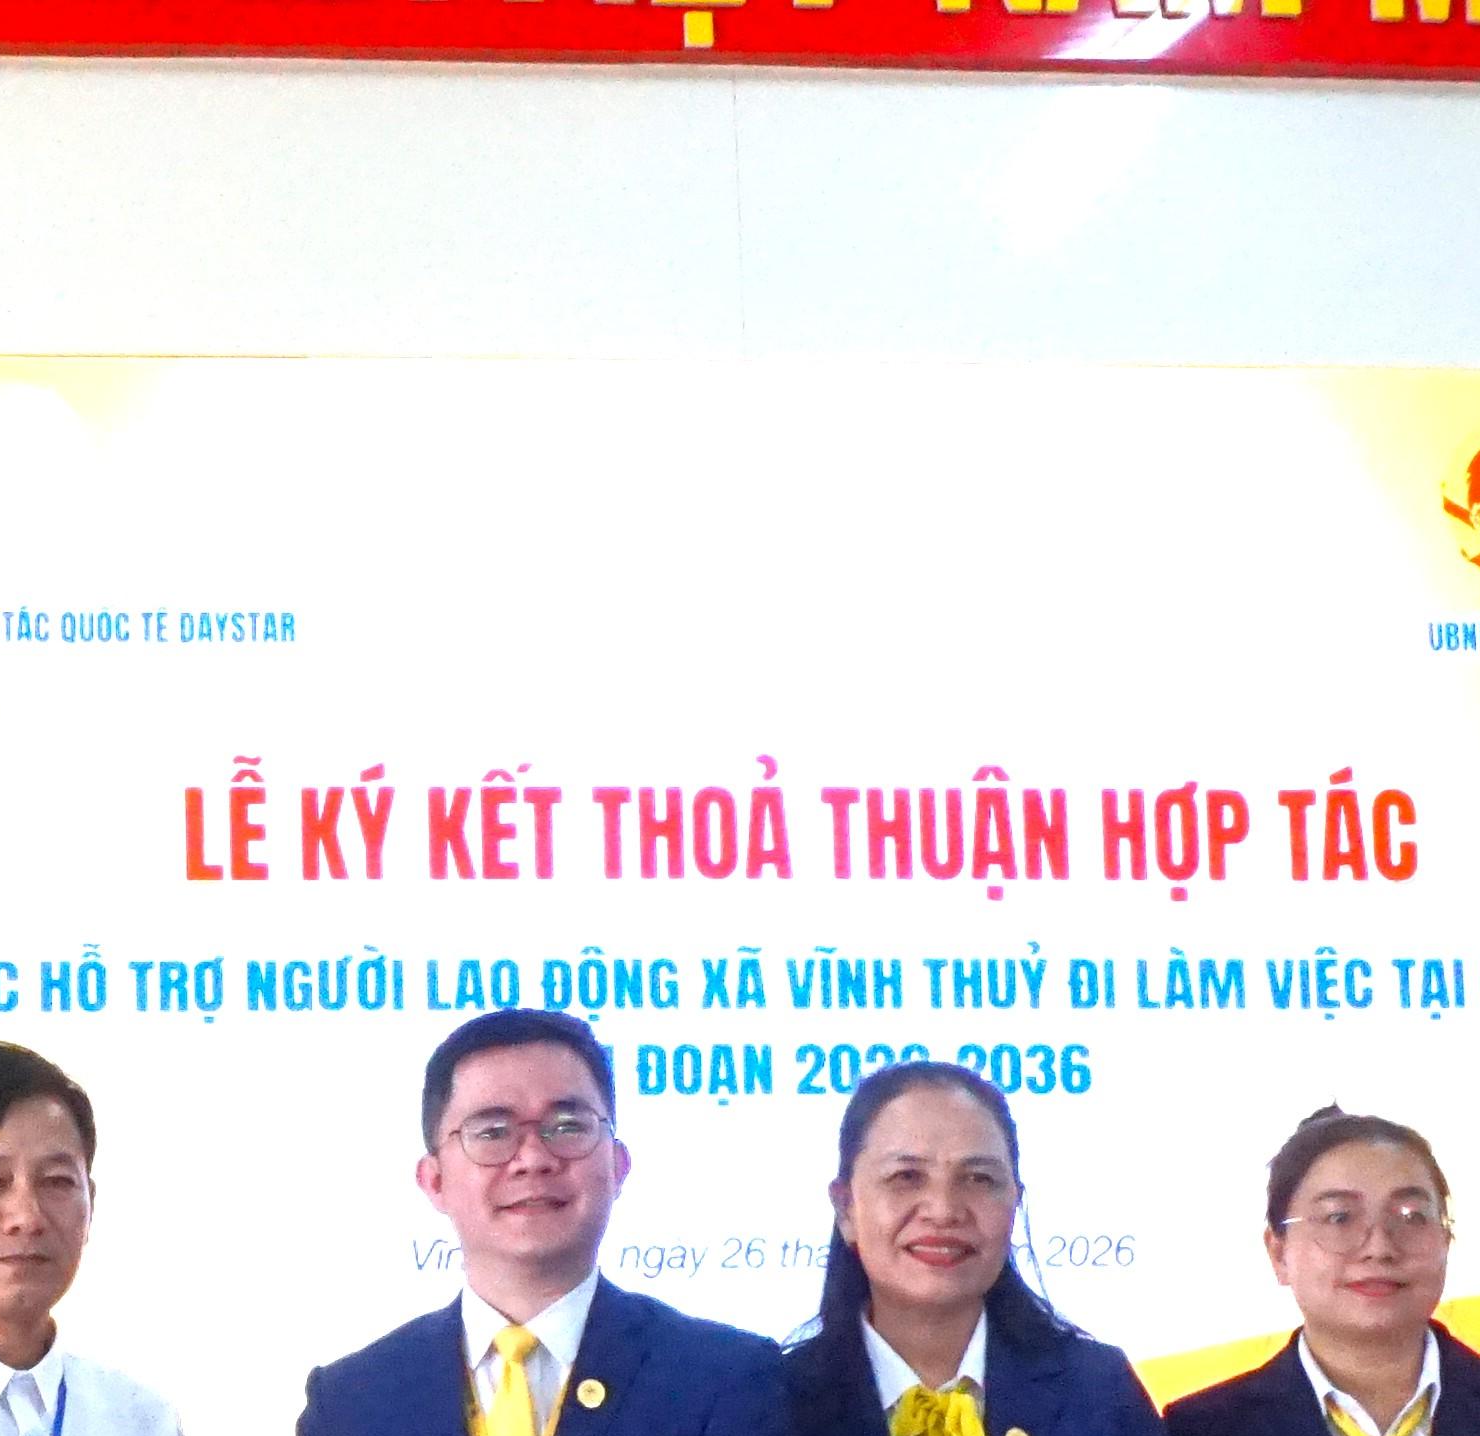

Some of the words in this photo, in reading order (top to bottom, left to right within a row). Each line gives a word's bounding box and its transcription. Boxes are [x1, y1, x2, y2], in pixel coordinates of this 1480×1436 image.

[2, 606, 51, 643] TÁC
[180, 611, 297, 643] DAYSTAR
[183, 754, 270, 881] LỄ
[300, 761, 396, 881] KÝ
[426, 762, 563, 881] KẾT
[590, 753, 794, 881] THOẢ
[820, 763, 1071, 902] THUẬN
[1100, 780, 1251, 902] HỢP
[1276, 764, 1419, 882] TÁC
[40, 942, 108, 1013] HỖ
[127, 955, 225, 1024] TRỢ
[245, 944, 405, 1012] NGƯỜI
[426, 958, 521, 1011] LAO
[540, 945, 680, 1022] ĐỘNG
[701, 945, 767, 1009] XÃ
[785, 944, 903, 1010] VĨNH
[922, 940, 1048, 1010] THUỶ
[1067, 958, 1116, 1010] ĐI
[1136, 945, 1246, 1010] LÀM
[1265, 946, 1374, 1022] VIỆC
[1392, 958, 1466, 1022] TẠI
[636, 1044, 773, 1107] ĐOẠN
[720, 1237, 767, 1269] 26
[1045, 1234, 1136, 1267] 2026
